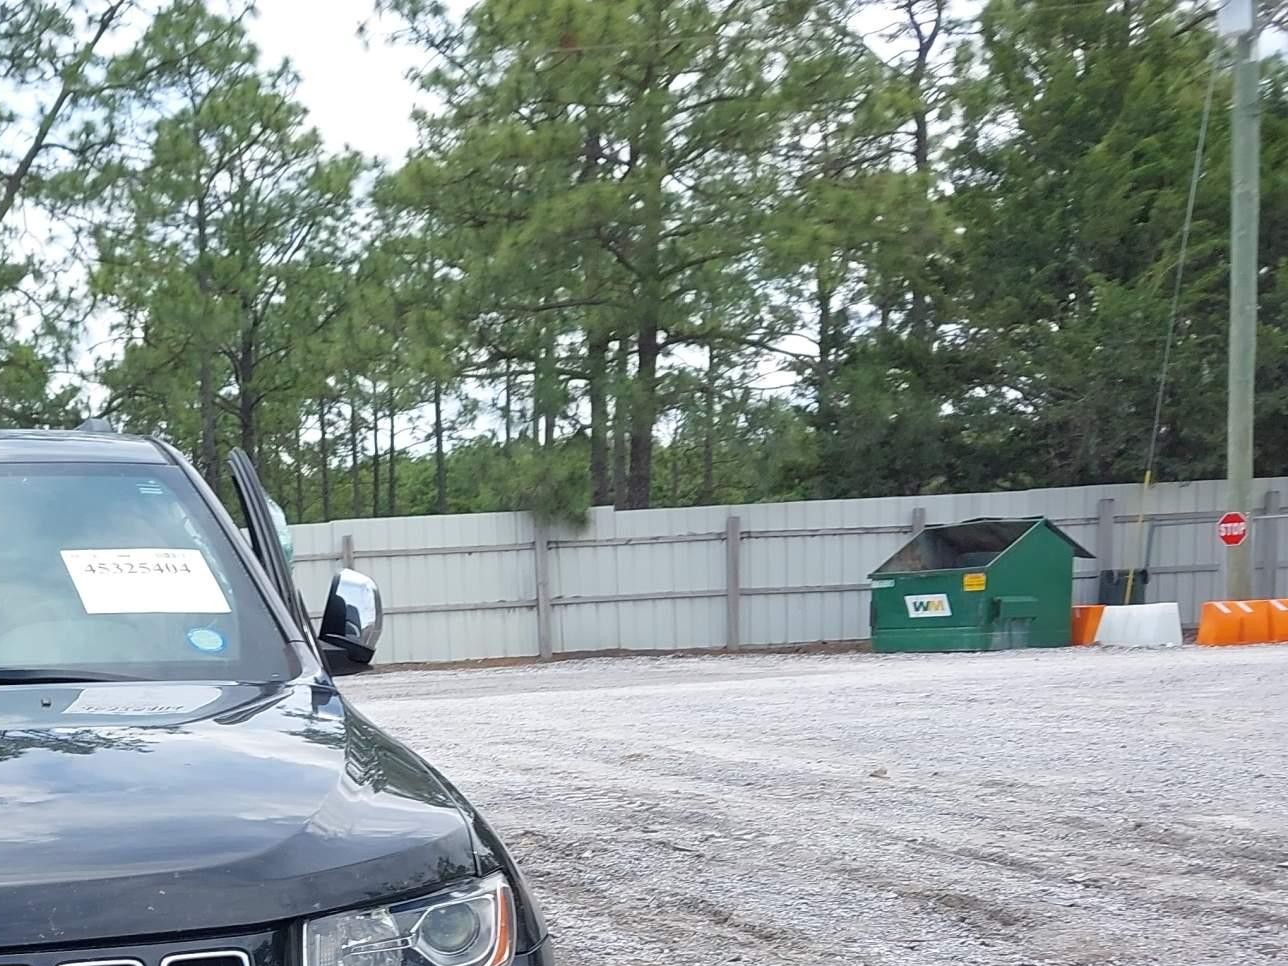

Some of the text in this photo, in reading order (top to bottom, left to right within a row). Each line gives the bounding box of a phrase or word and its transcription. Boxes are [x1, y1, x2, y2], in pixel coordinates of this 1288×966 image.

[1219, 522, 1246, 537] STOP
[85, 562, 192, 576] 45325404
[912, 600, 945, 612] WM
